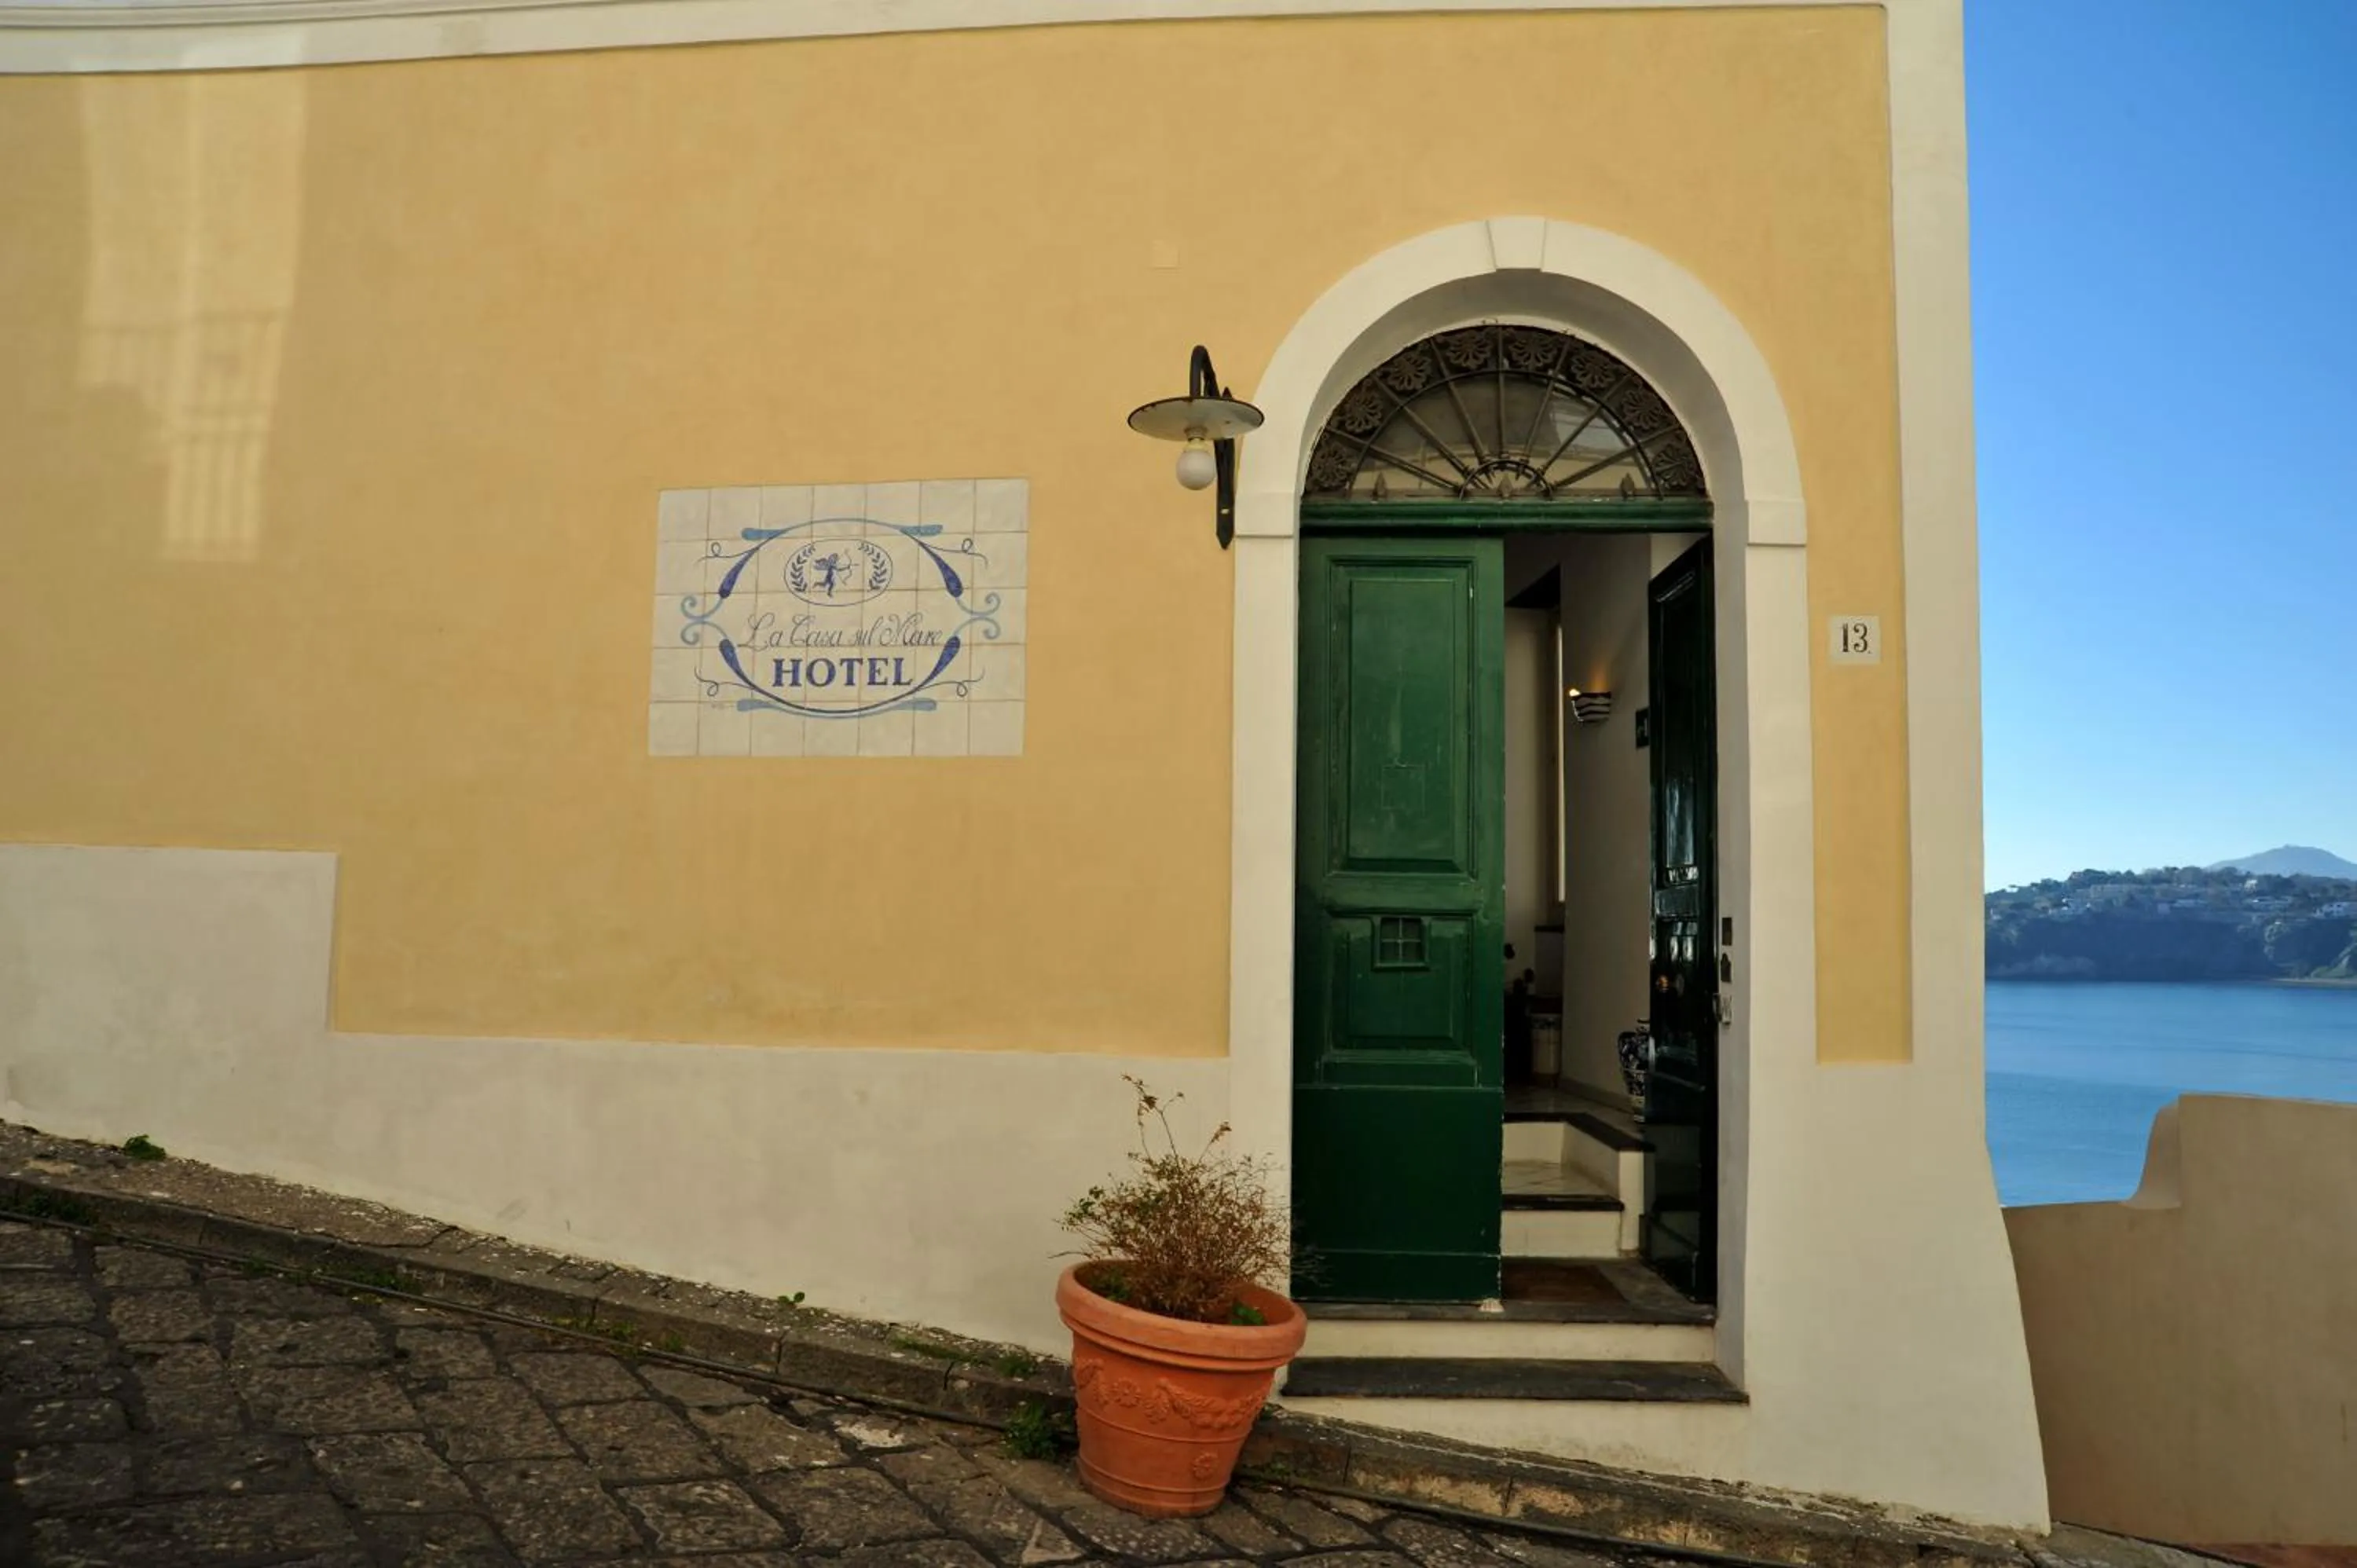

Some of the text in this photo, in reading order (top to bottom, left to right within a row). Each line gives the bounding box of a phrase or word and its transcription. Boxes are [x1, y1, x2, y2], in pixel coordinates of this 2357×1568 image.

[738, 611, 943, 651] La Casa sul Mare
[1842, 622, 1868, 653] 13
[772, 658, 913, 687] HOTEL
